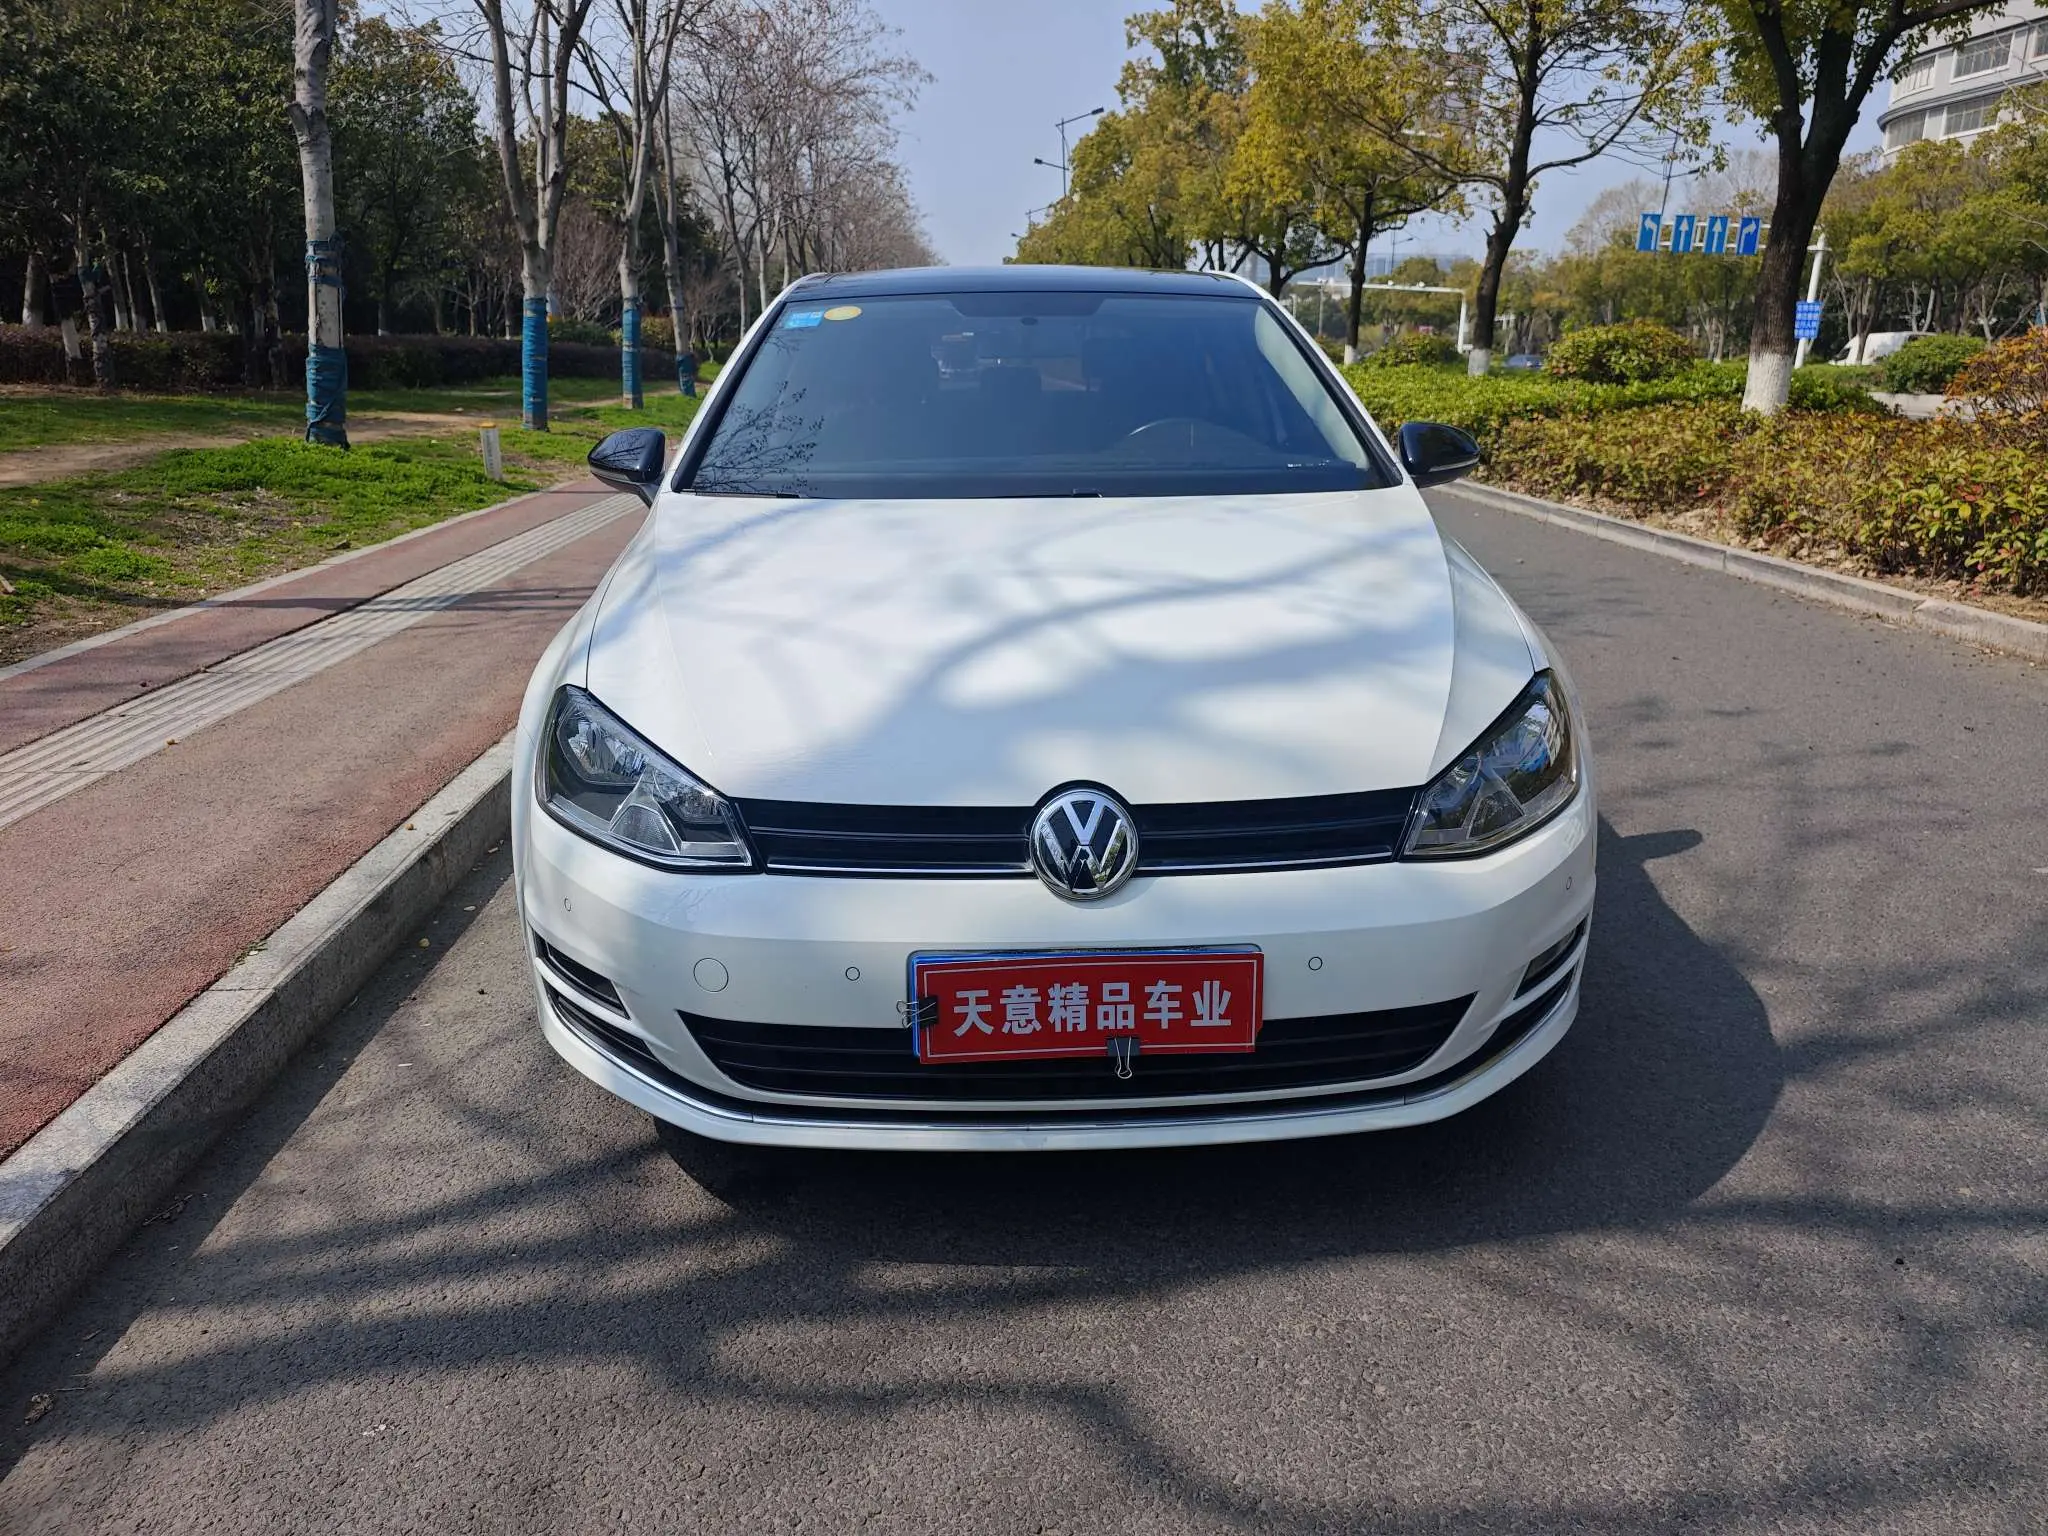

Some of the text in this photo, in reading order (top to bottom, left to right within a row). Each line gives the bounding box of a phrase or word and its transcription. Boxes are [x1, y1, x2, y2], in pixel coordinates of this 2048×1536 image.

[1034, 793, 1132, 895] VW
[953, 979, 1232, 1038] 天意精品车业
